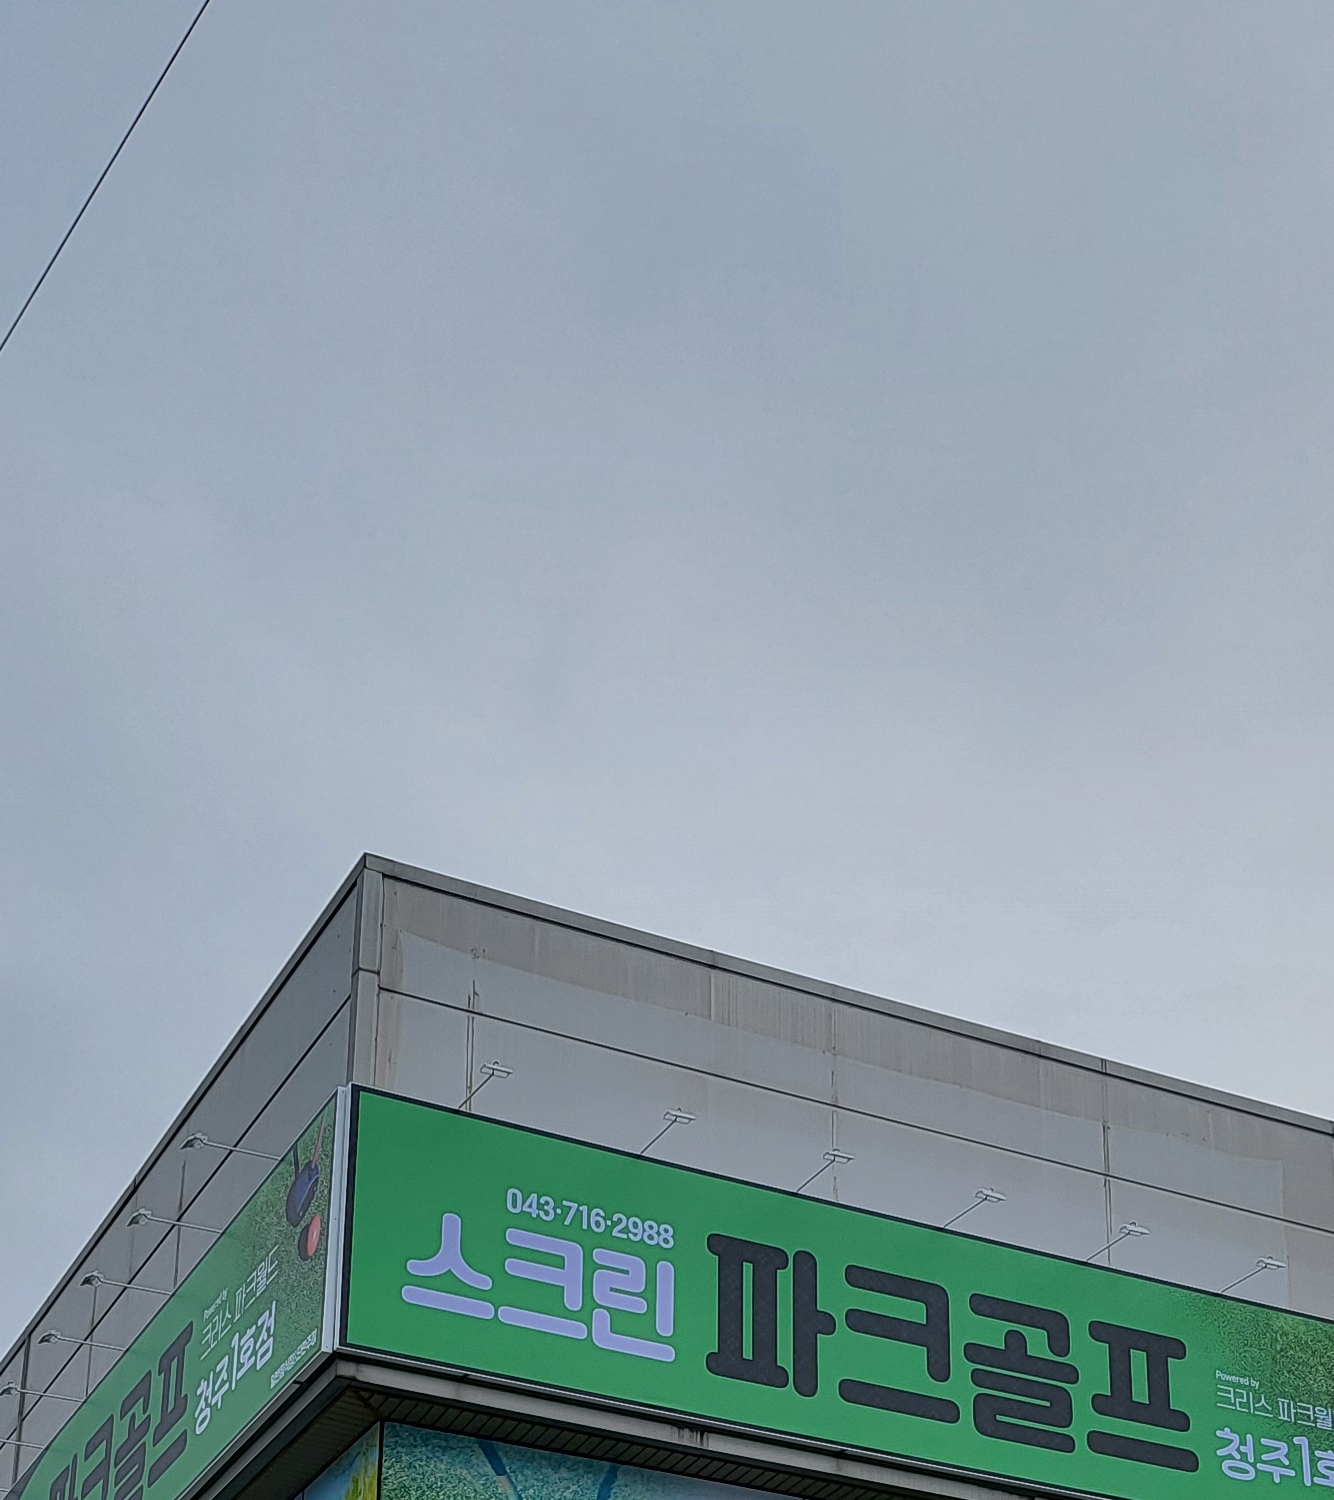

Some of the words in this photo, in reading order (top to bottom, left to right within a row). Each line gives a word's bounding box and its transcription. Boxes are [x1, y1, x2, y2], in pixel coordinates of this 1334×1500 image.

[200, 1309, 232, 1361] 크리스
[233, 1245, 279, 1323] 파크월드
[400, 1212, 677, 1363] 스크린
[705, 1232, 1200, 1473] 파크골프
[195, 1300, 277, 1436] 청주1호점
[1215, 1370, 1248, 1387] Powered
[1249, 1376, 1260, 1390] by
[1216, 1384, 1274, 1418] 크리스
